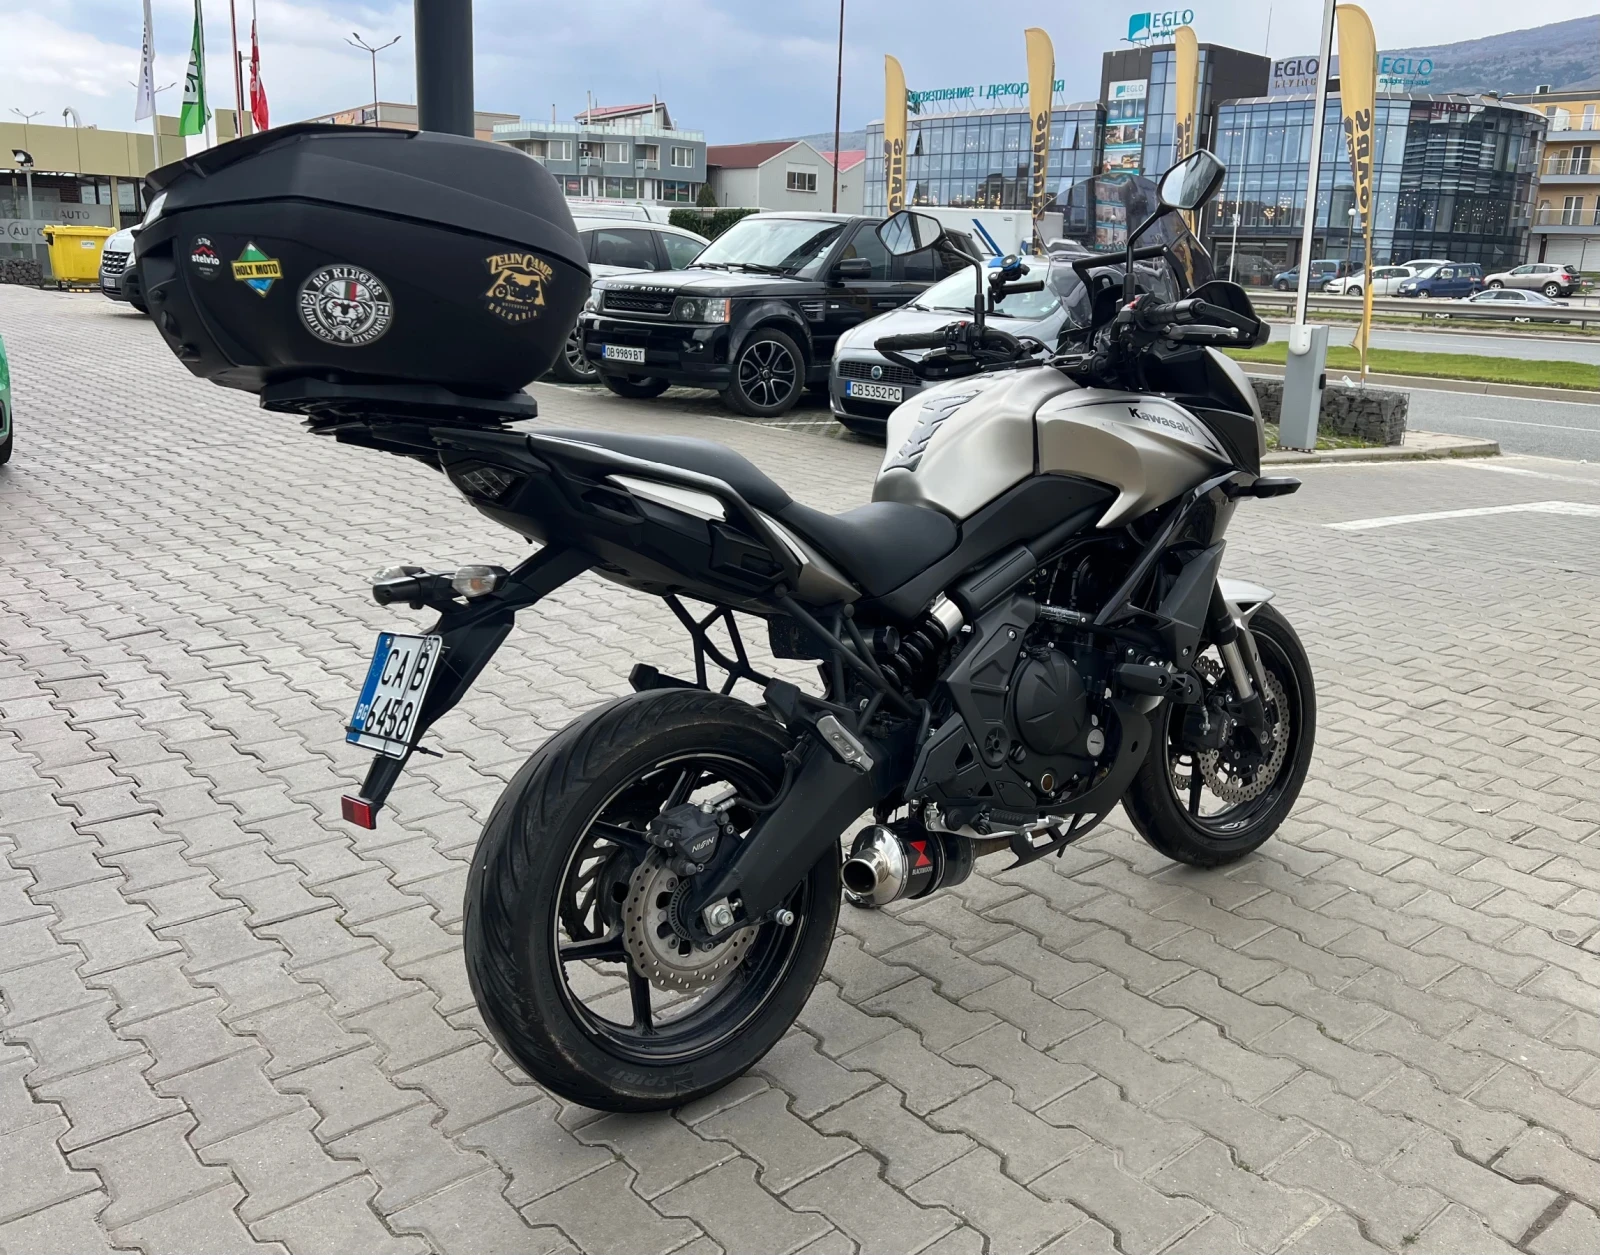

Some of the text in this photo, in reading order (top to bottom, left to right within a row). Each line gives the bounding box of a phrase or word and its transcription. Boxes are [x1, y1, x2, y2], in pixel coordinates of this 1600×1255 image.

[1152, 9, 1194, 28] EGLO
[1273, 58, 1320, 78] EGLO
[1380, 56, 1434, 76] EGLO
[1126, 84, 1144, 93] EGLO
[1274, 78, 1317, 88] LIVING
[59, 209, 90, 220] AUTO
[13, 227, 44, 236] AUO
[191, 253, 220, 265] stelvio
[234, 263, 279, 276] HOLY MOTO
[640, 286, 675, 294] ROVER
[301, 294, 316, 304] 20
[377, 305, 390, 316] 21
[488, 302, 538, 321] BULGARIA
[864, 385, 887, 399] 5352
[1128, 406, 1195, 437] Kawasaki
[355, 703, 369, 721] BG
[364, 695, 414, 740] 6458
